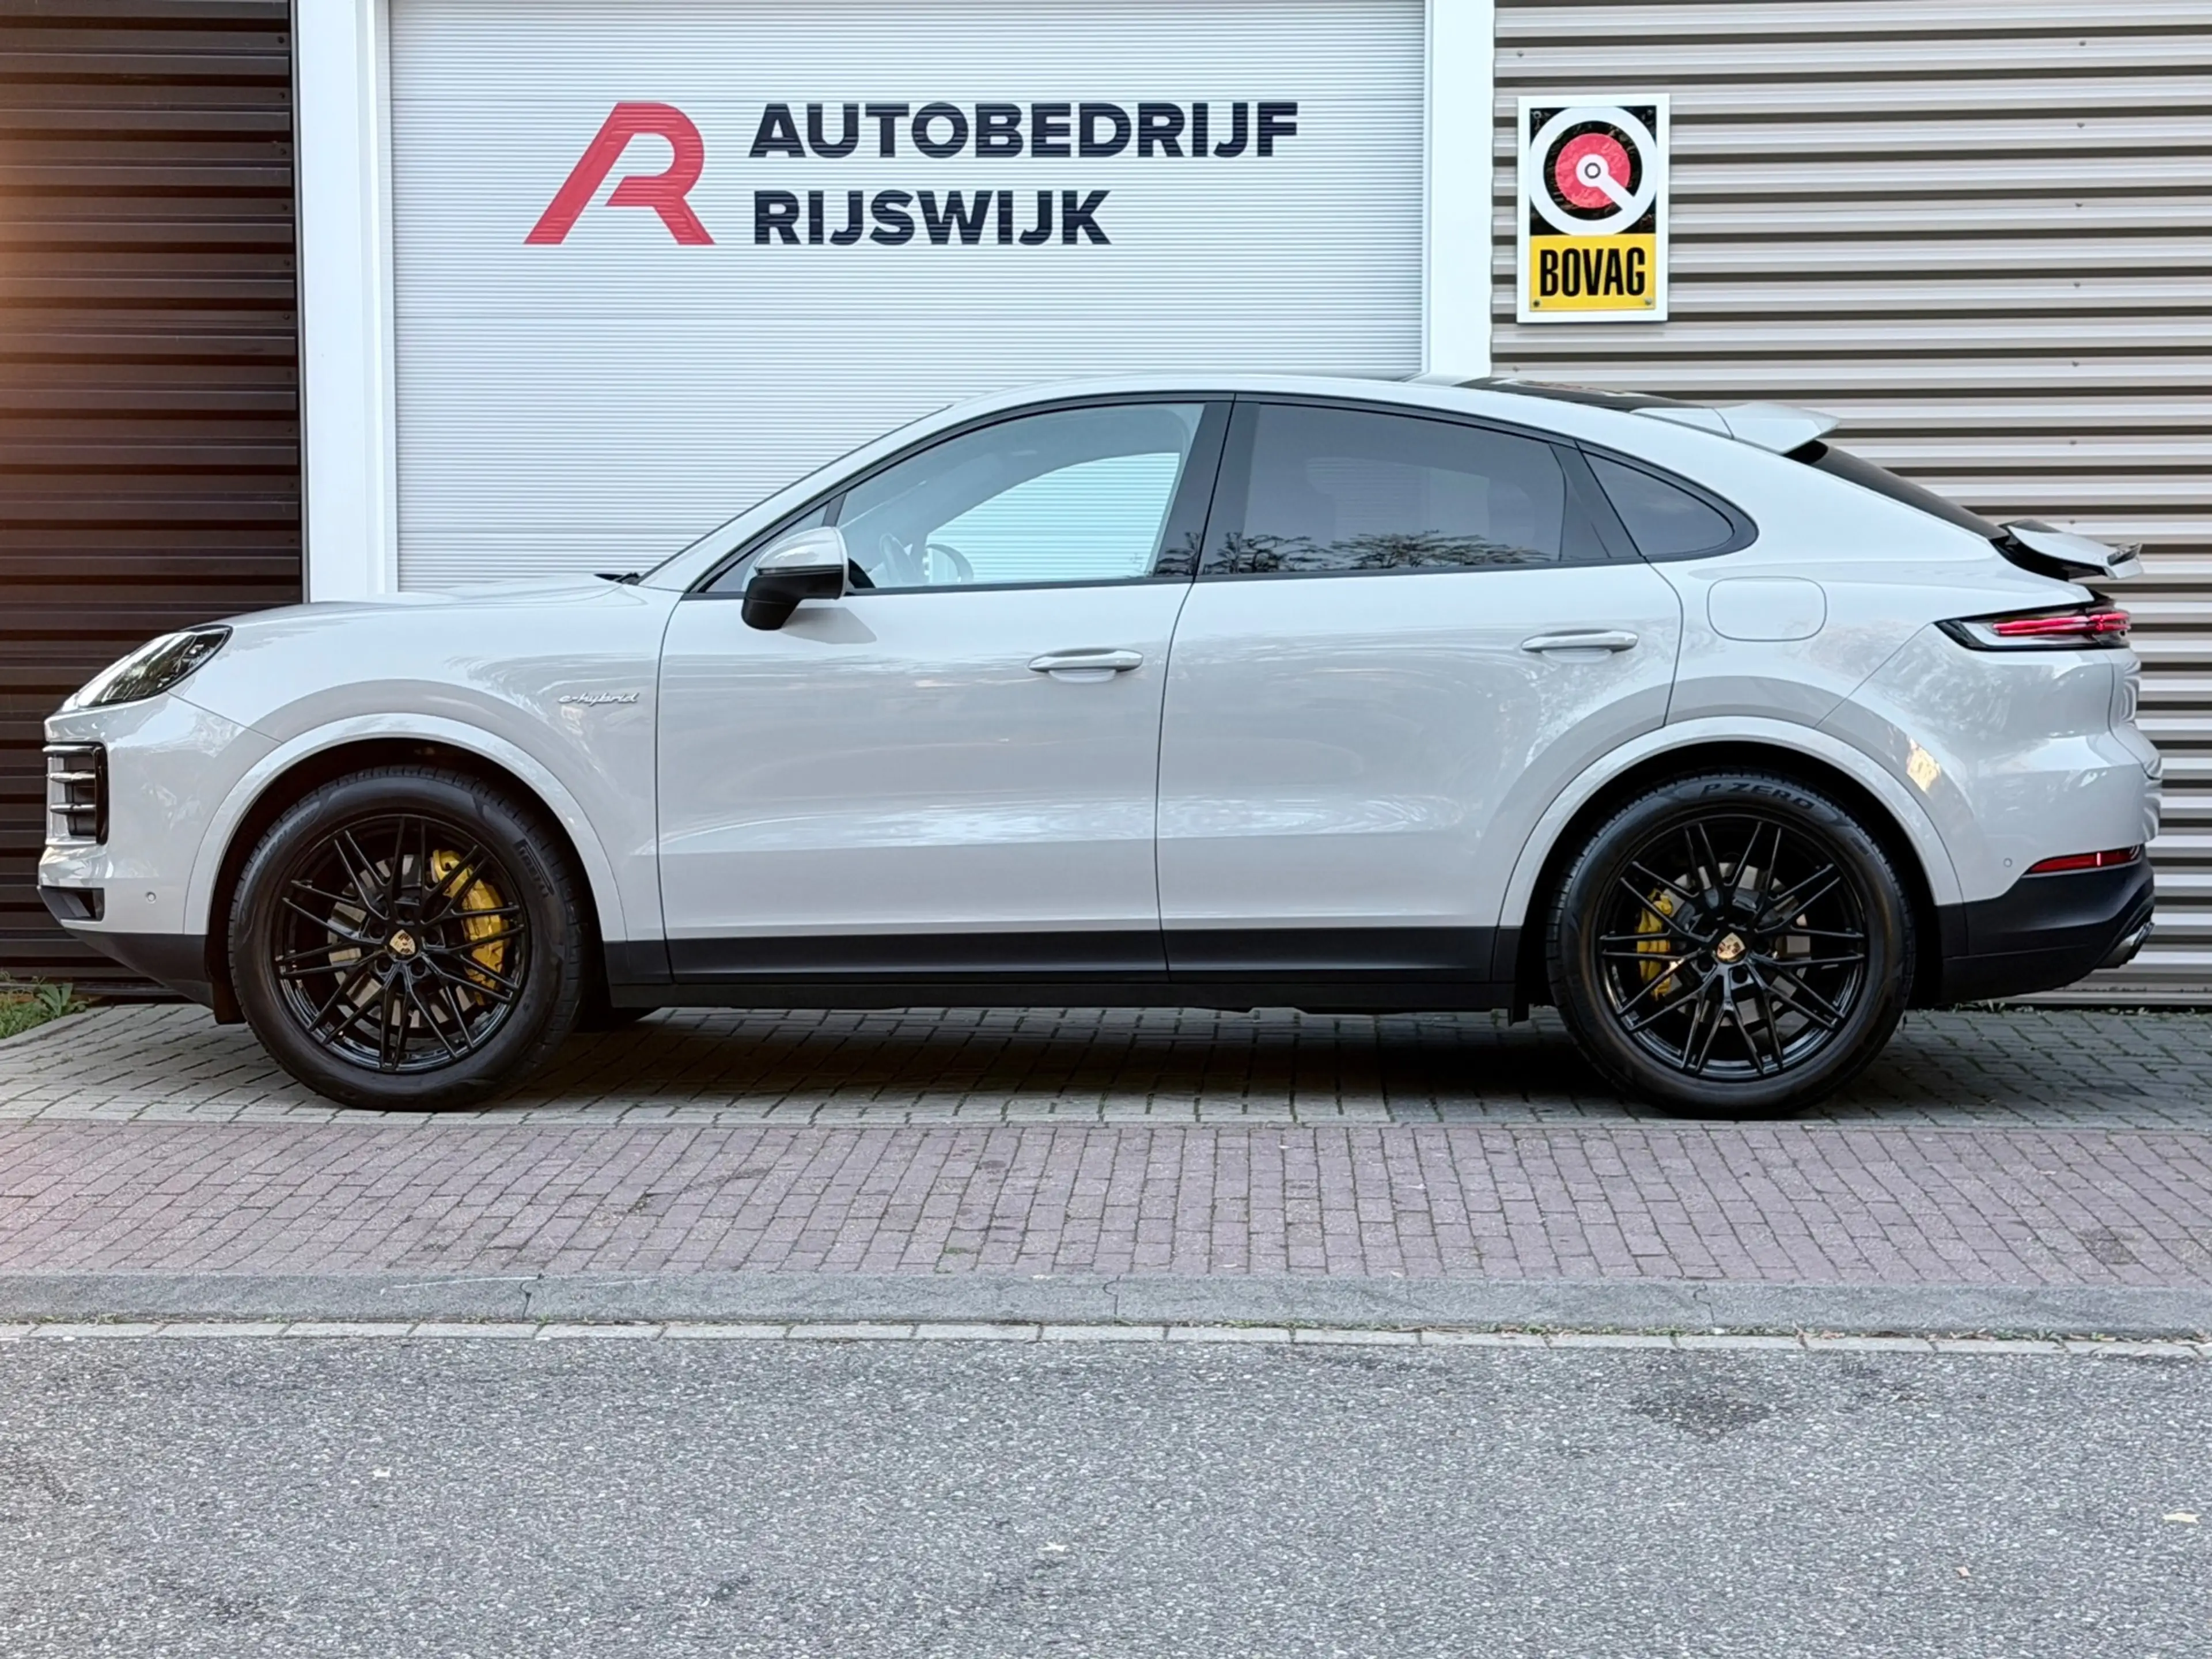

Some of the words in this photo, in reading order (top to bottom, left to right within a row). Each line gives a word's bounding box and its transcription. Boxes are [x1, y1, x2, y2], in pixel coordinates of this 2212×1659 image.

[750, 102, 1298, 158] AUTOBEDRIJF
[754, 190, 1111, 245] RIJSWIJK
[1540, 247, 1645, 297] BOVAG
[558, 692, 640, 707] e-hybrid
[1701, 783, 1722, 796] P
[1728, 782, 1815, 810] ZERO
